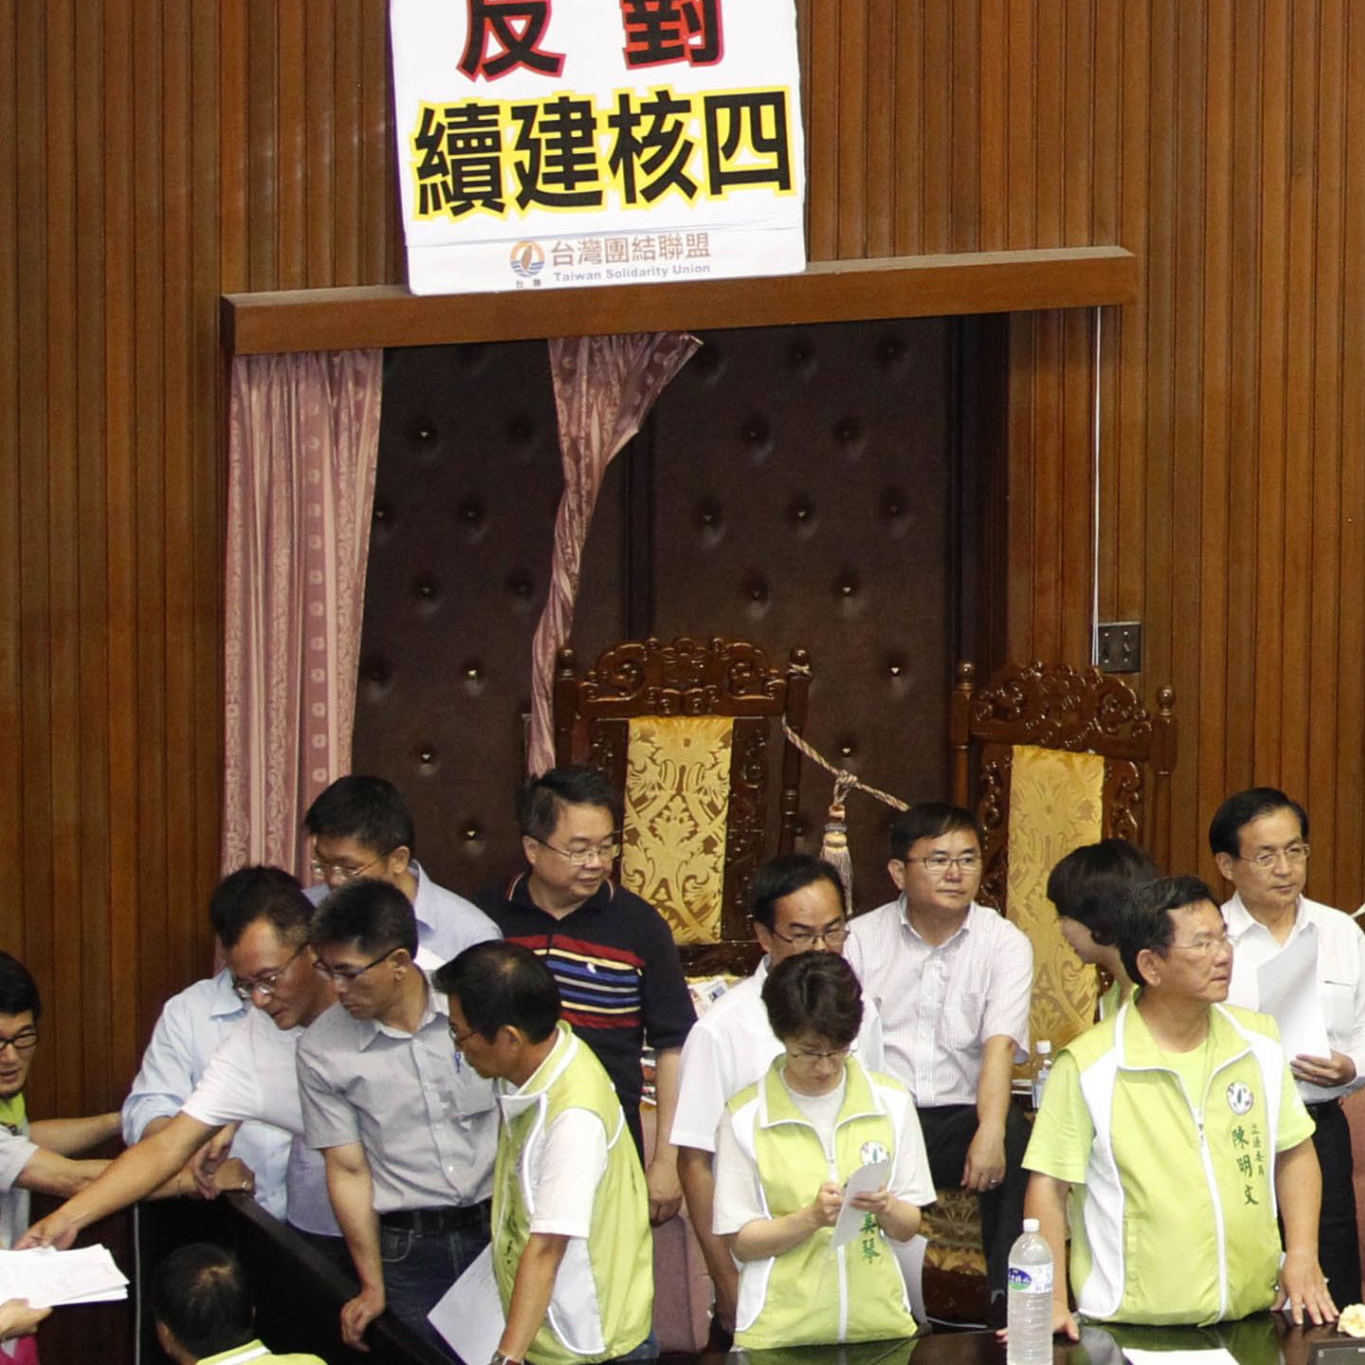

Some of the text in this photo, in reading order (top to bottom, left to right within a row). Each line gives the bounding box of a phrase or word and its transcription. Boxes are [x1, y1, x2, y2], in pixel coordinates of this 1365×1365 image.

[412, 87, 794, 219] 續建核四
[551, 232, 711, 267] 台灣團結聯盟
[554, 263, 710, 282] Taiwan Solidarity Union
